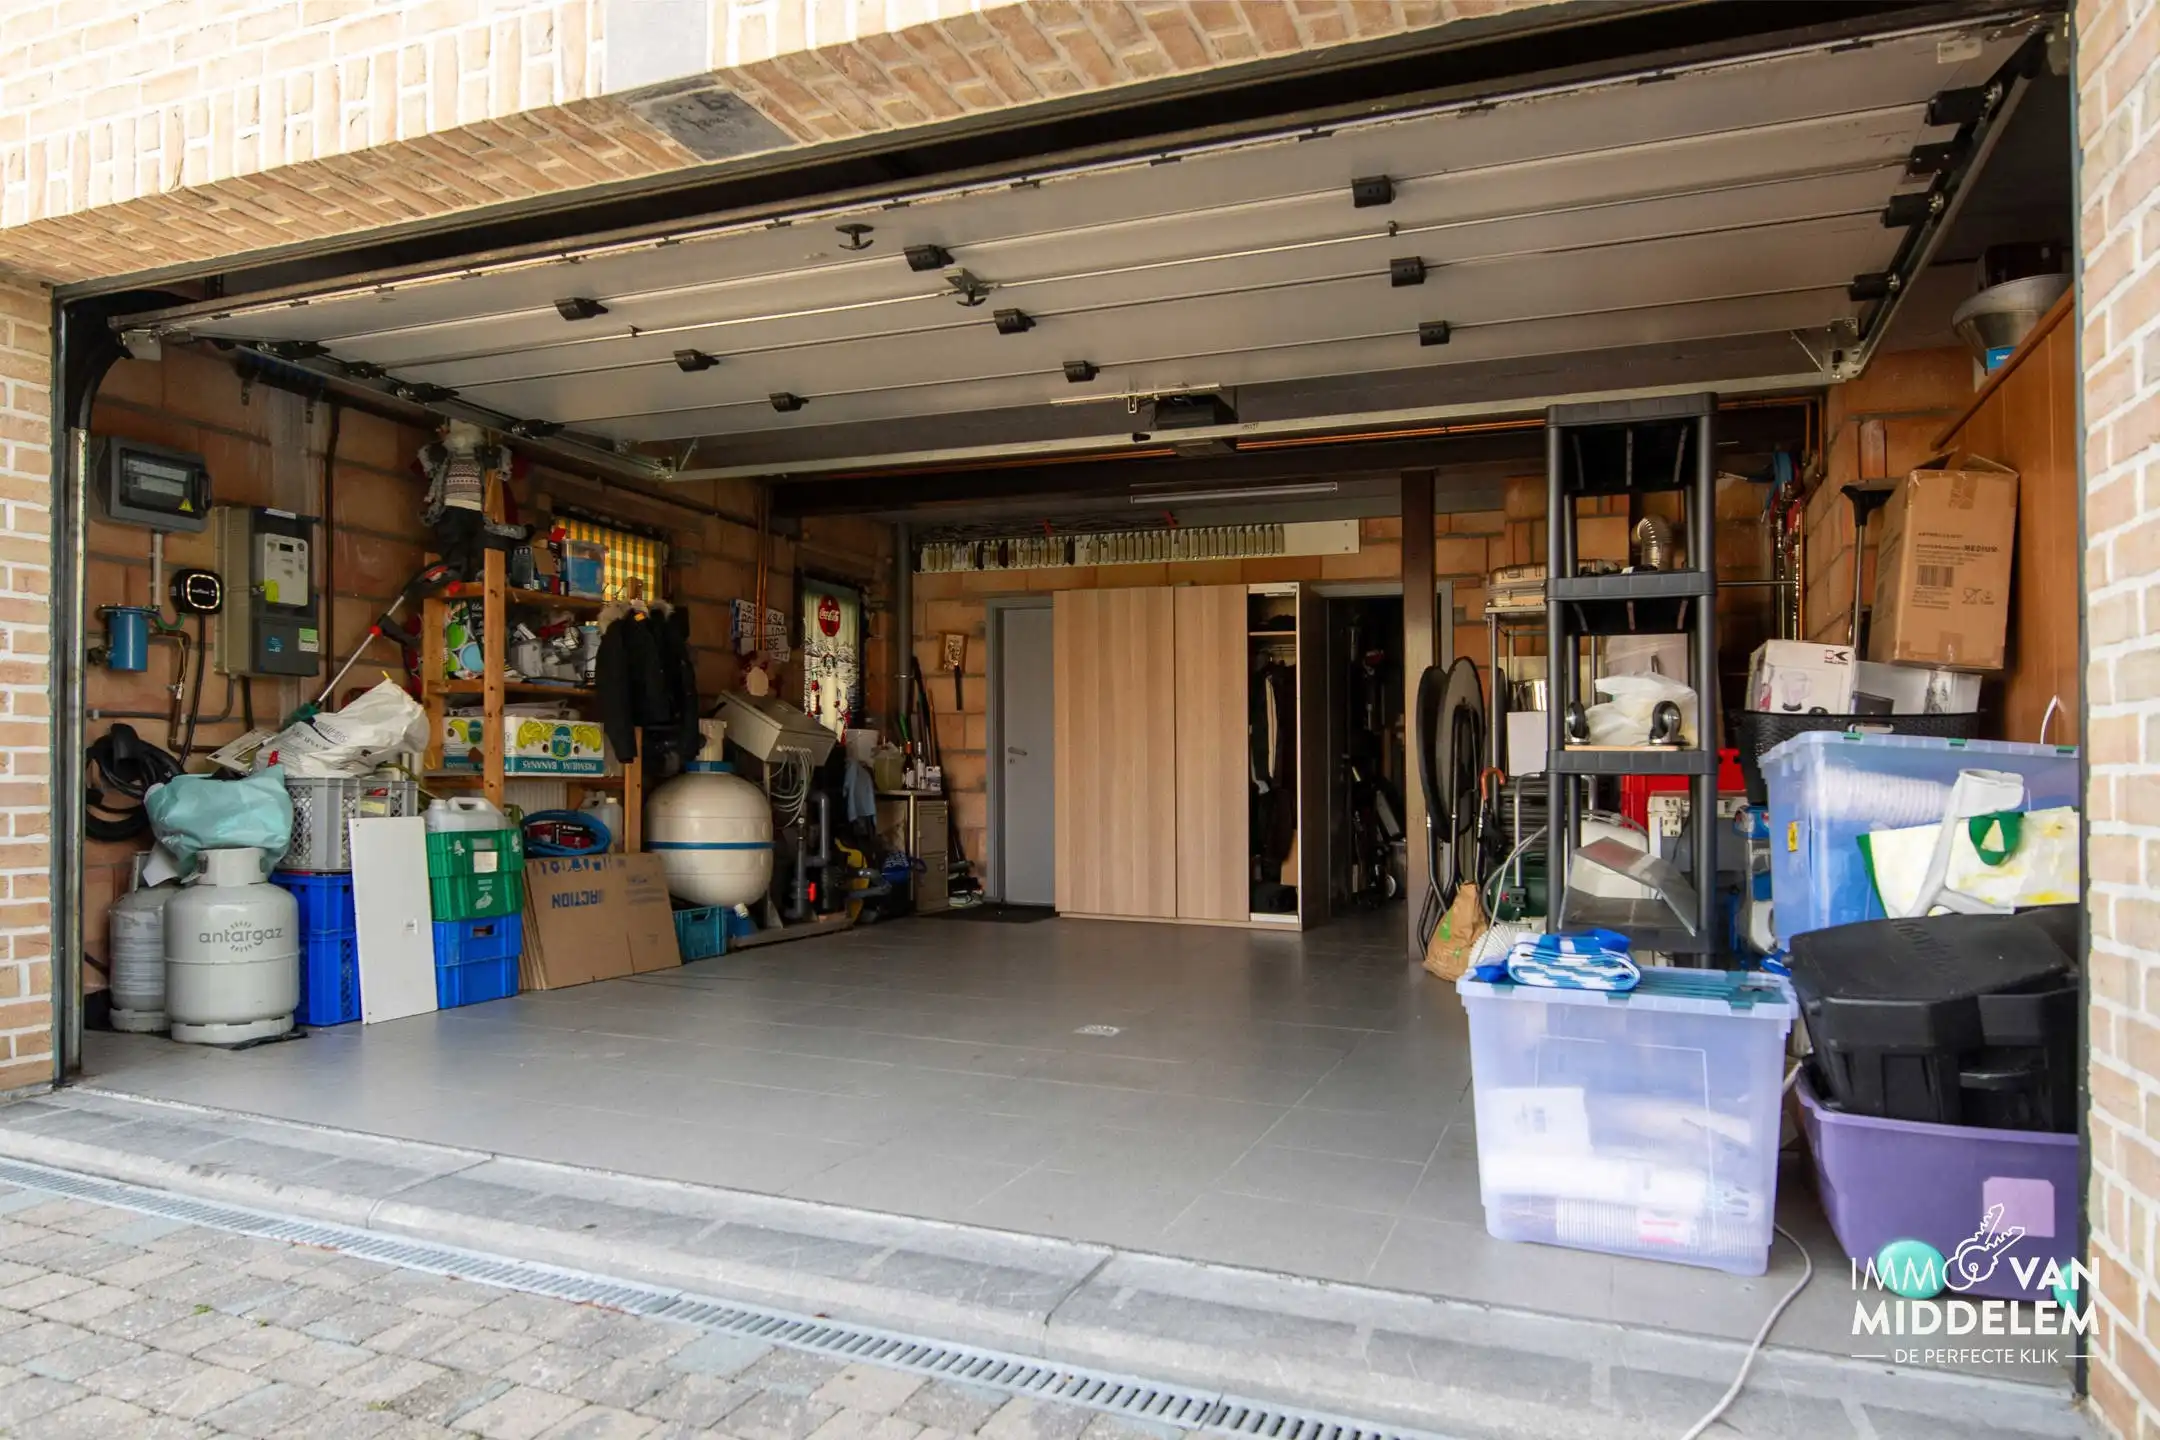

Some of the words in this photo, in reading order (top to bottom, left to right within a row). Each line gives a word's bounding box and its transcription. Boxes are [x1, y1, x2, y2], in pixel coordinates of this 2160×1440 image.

[522, 759, 557, 770] BANANAS
[551, 889, 599, 909] ACTION
[199, 927, 284, 946] antargaz
